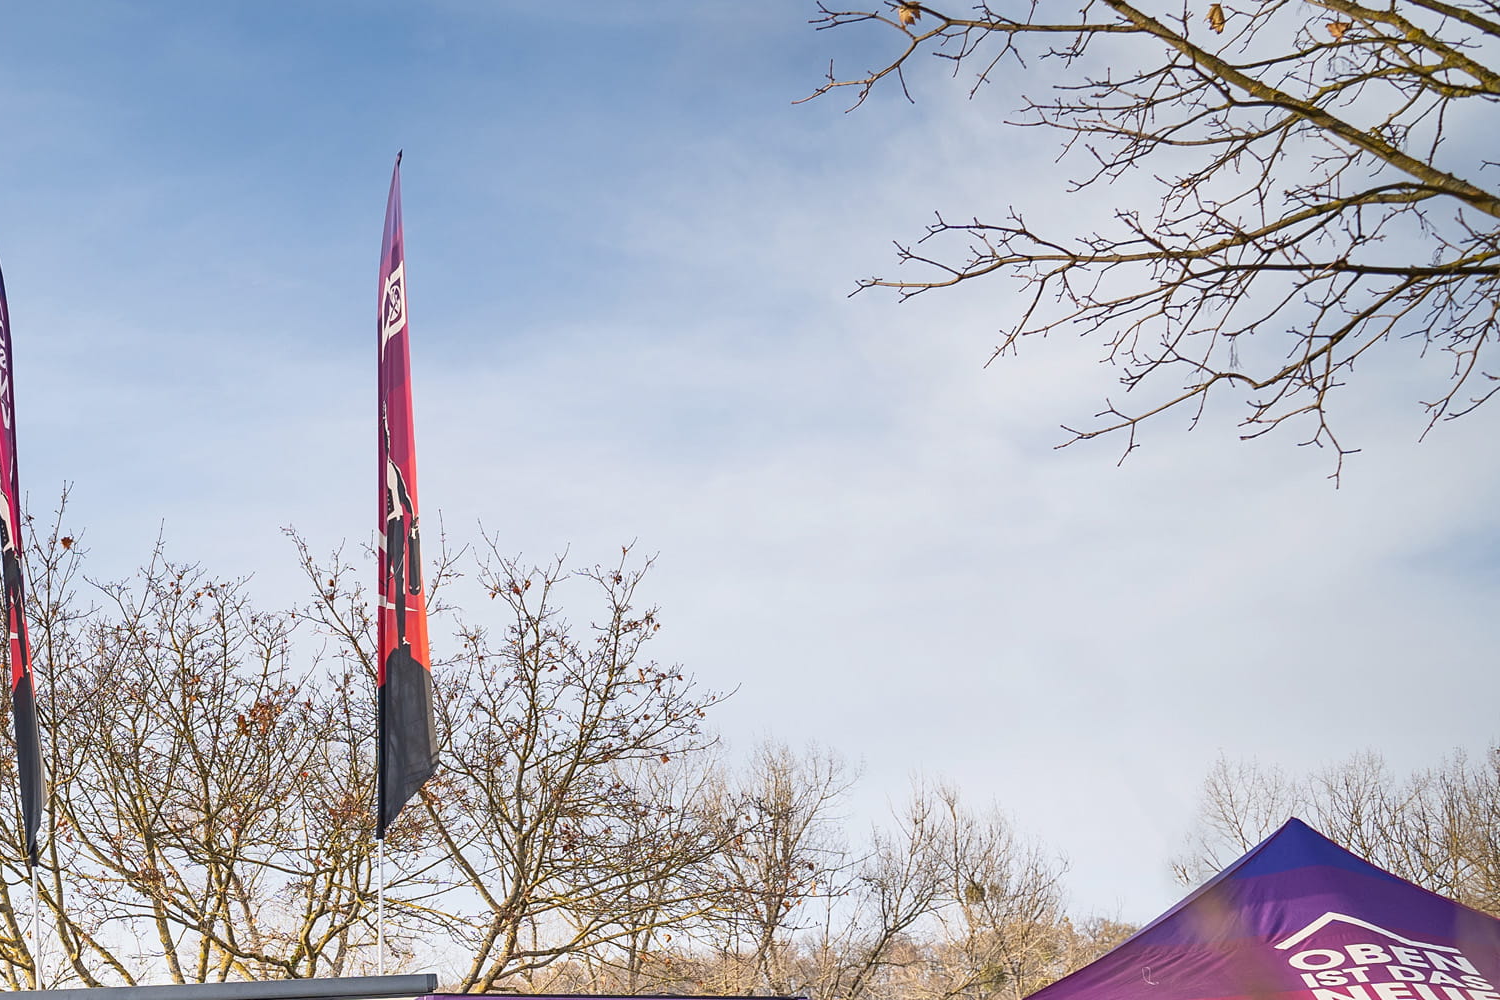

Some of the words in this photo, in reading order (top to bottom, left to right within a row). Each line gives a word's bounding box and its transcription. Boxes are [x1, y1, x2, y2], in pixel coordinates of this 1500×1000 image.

[1288, 943, 1481, 977] OBEN
[1300, 966, 1370, 989] IST
[1385, 965, 1494, 991] DAS
